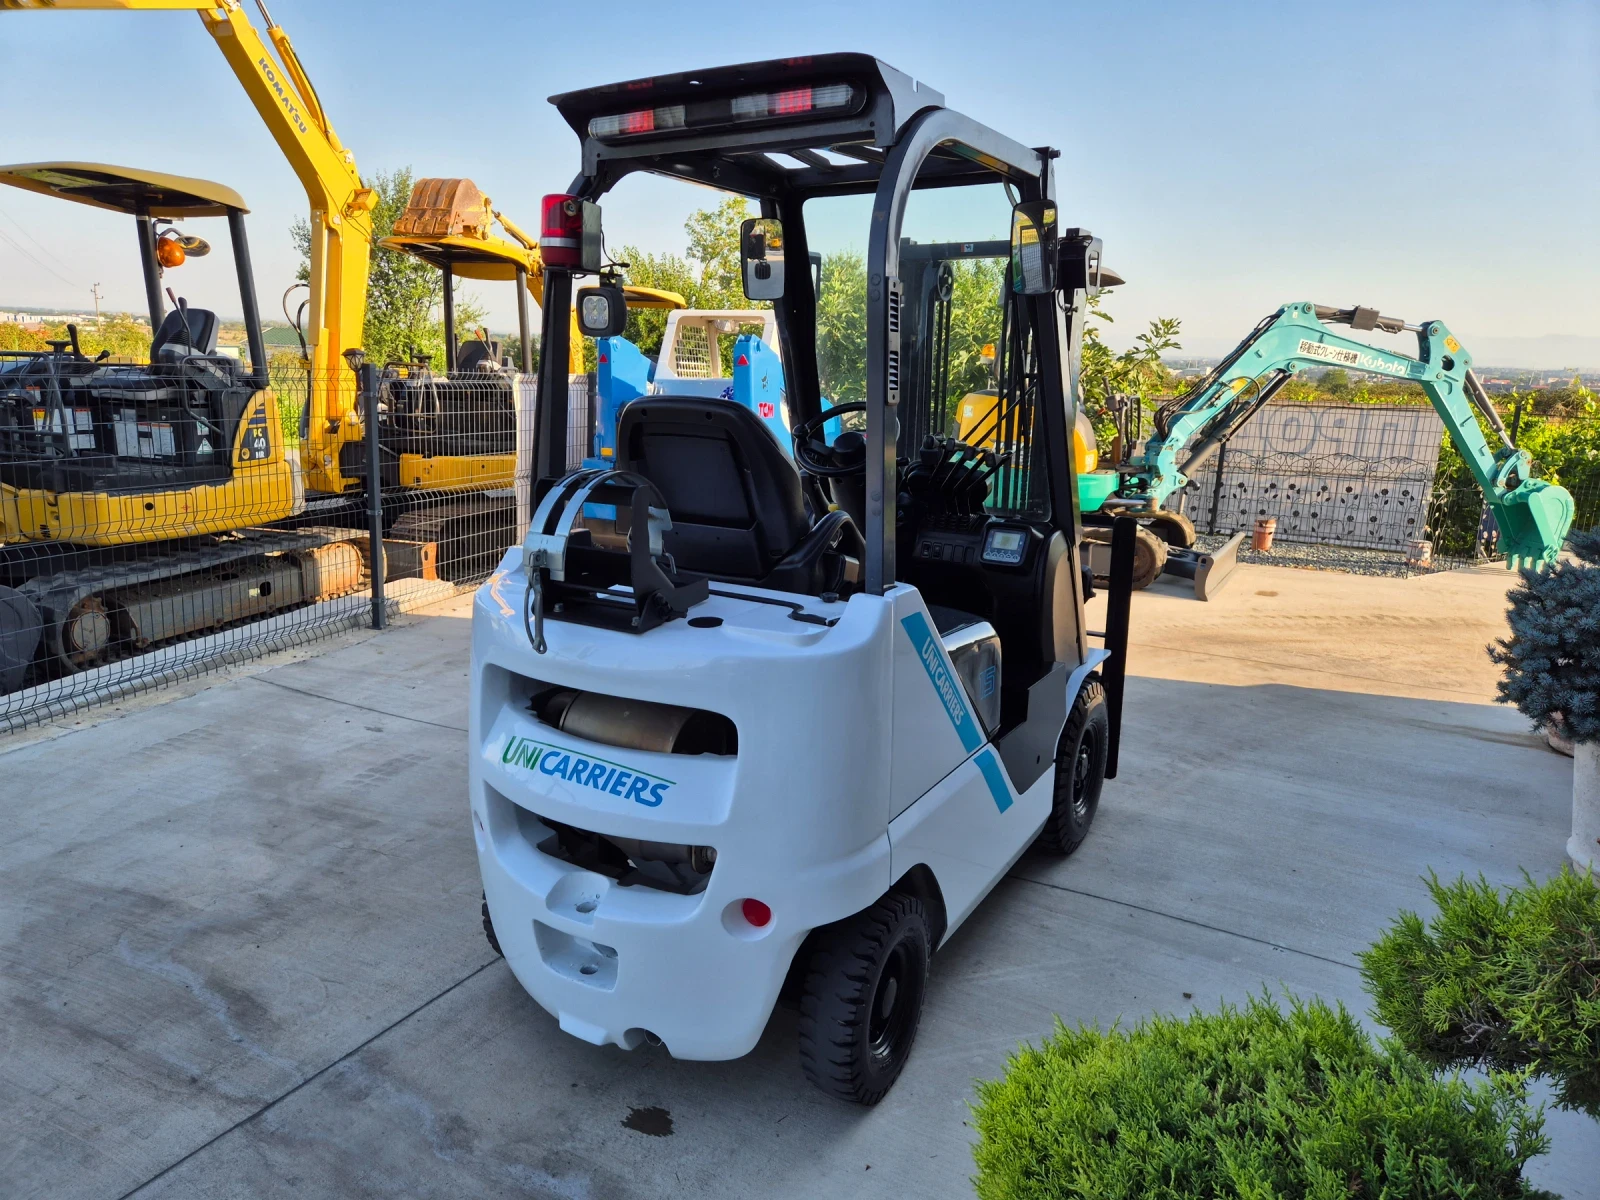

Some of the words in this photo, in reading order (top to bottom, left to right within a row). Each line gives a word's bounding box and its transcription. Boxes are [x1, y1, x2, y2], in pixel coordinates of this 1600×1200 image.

[258, 57, 307, 134] KOMATSU
[1360, 353, 1406, 376] Kubota
[758, 402, 774, 418] TCM
[253, 428, 263, 437] PC
[253, 437, 266, 449] 40
[921, 636, 965, 725] UNICARRIERS
[502, 735, 674, 807] UNICARRIERS
